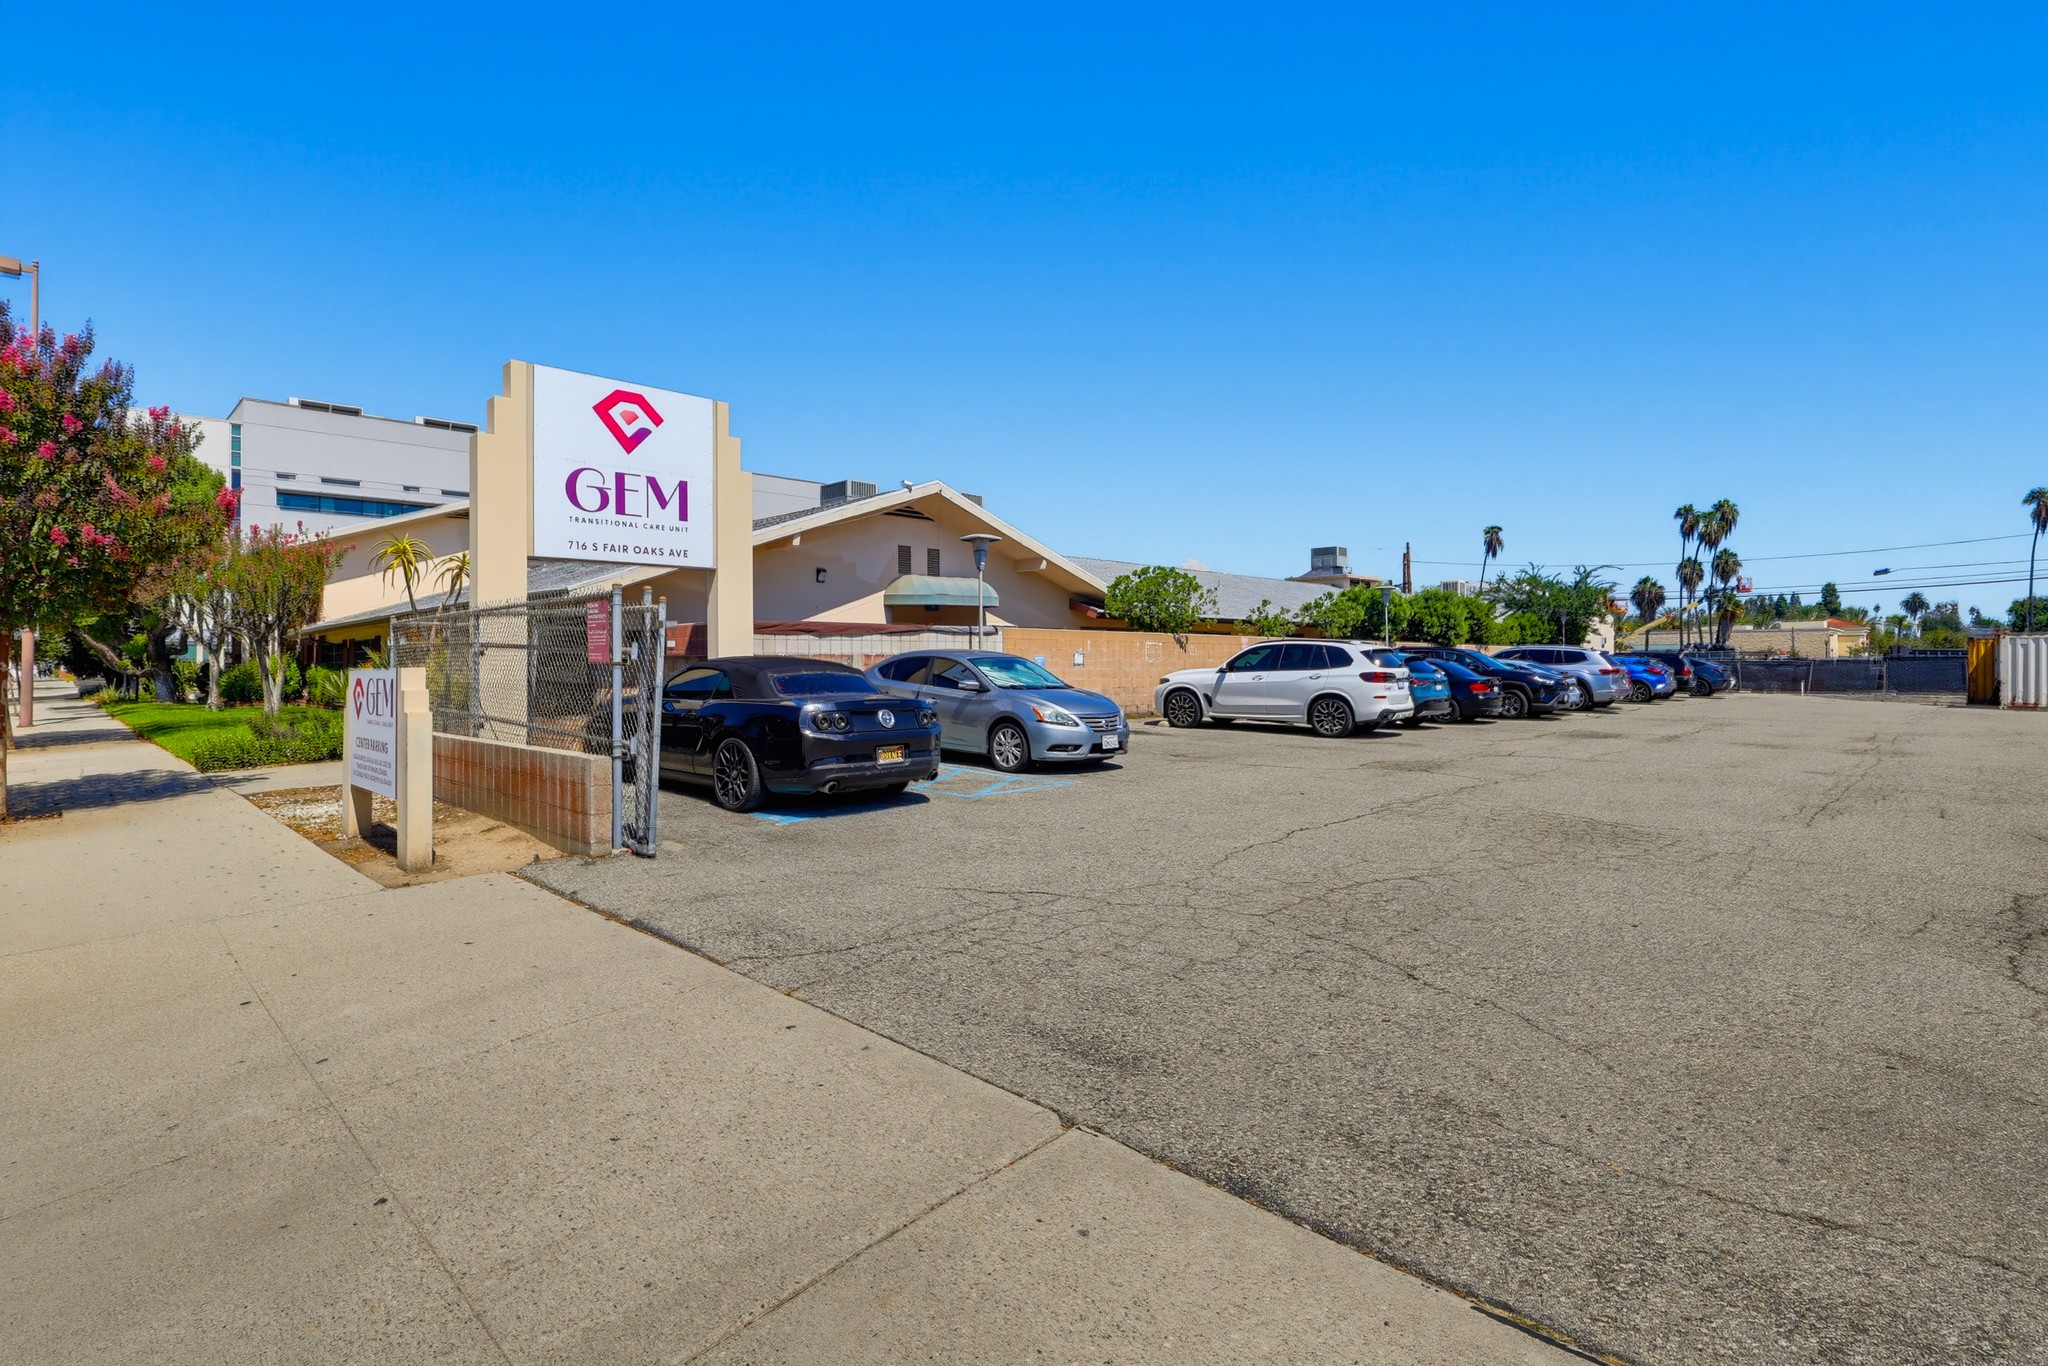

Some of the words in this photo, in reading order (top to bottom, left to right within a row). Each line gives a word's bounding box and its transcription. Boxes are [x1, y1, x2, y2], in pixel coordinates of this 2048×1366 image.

[565, 467, 688, 522] GEM
[569, 516, 639, 529] TRANSITIONAL
[643, 523, 665, 531] CARE
[568, 540, 587, 551] 716
[592, 542, 598, 551] S
[603, 543, 629, 554] FAIR
[633, 546, 664, 556] OAKS
[668, 548, 689, 558] AVE
[366, 678, 394, 718] GEM
[355, 736, 370, 750] CENTER
